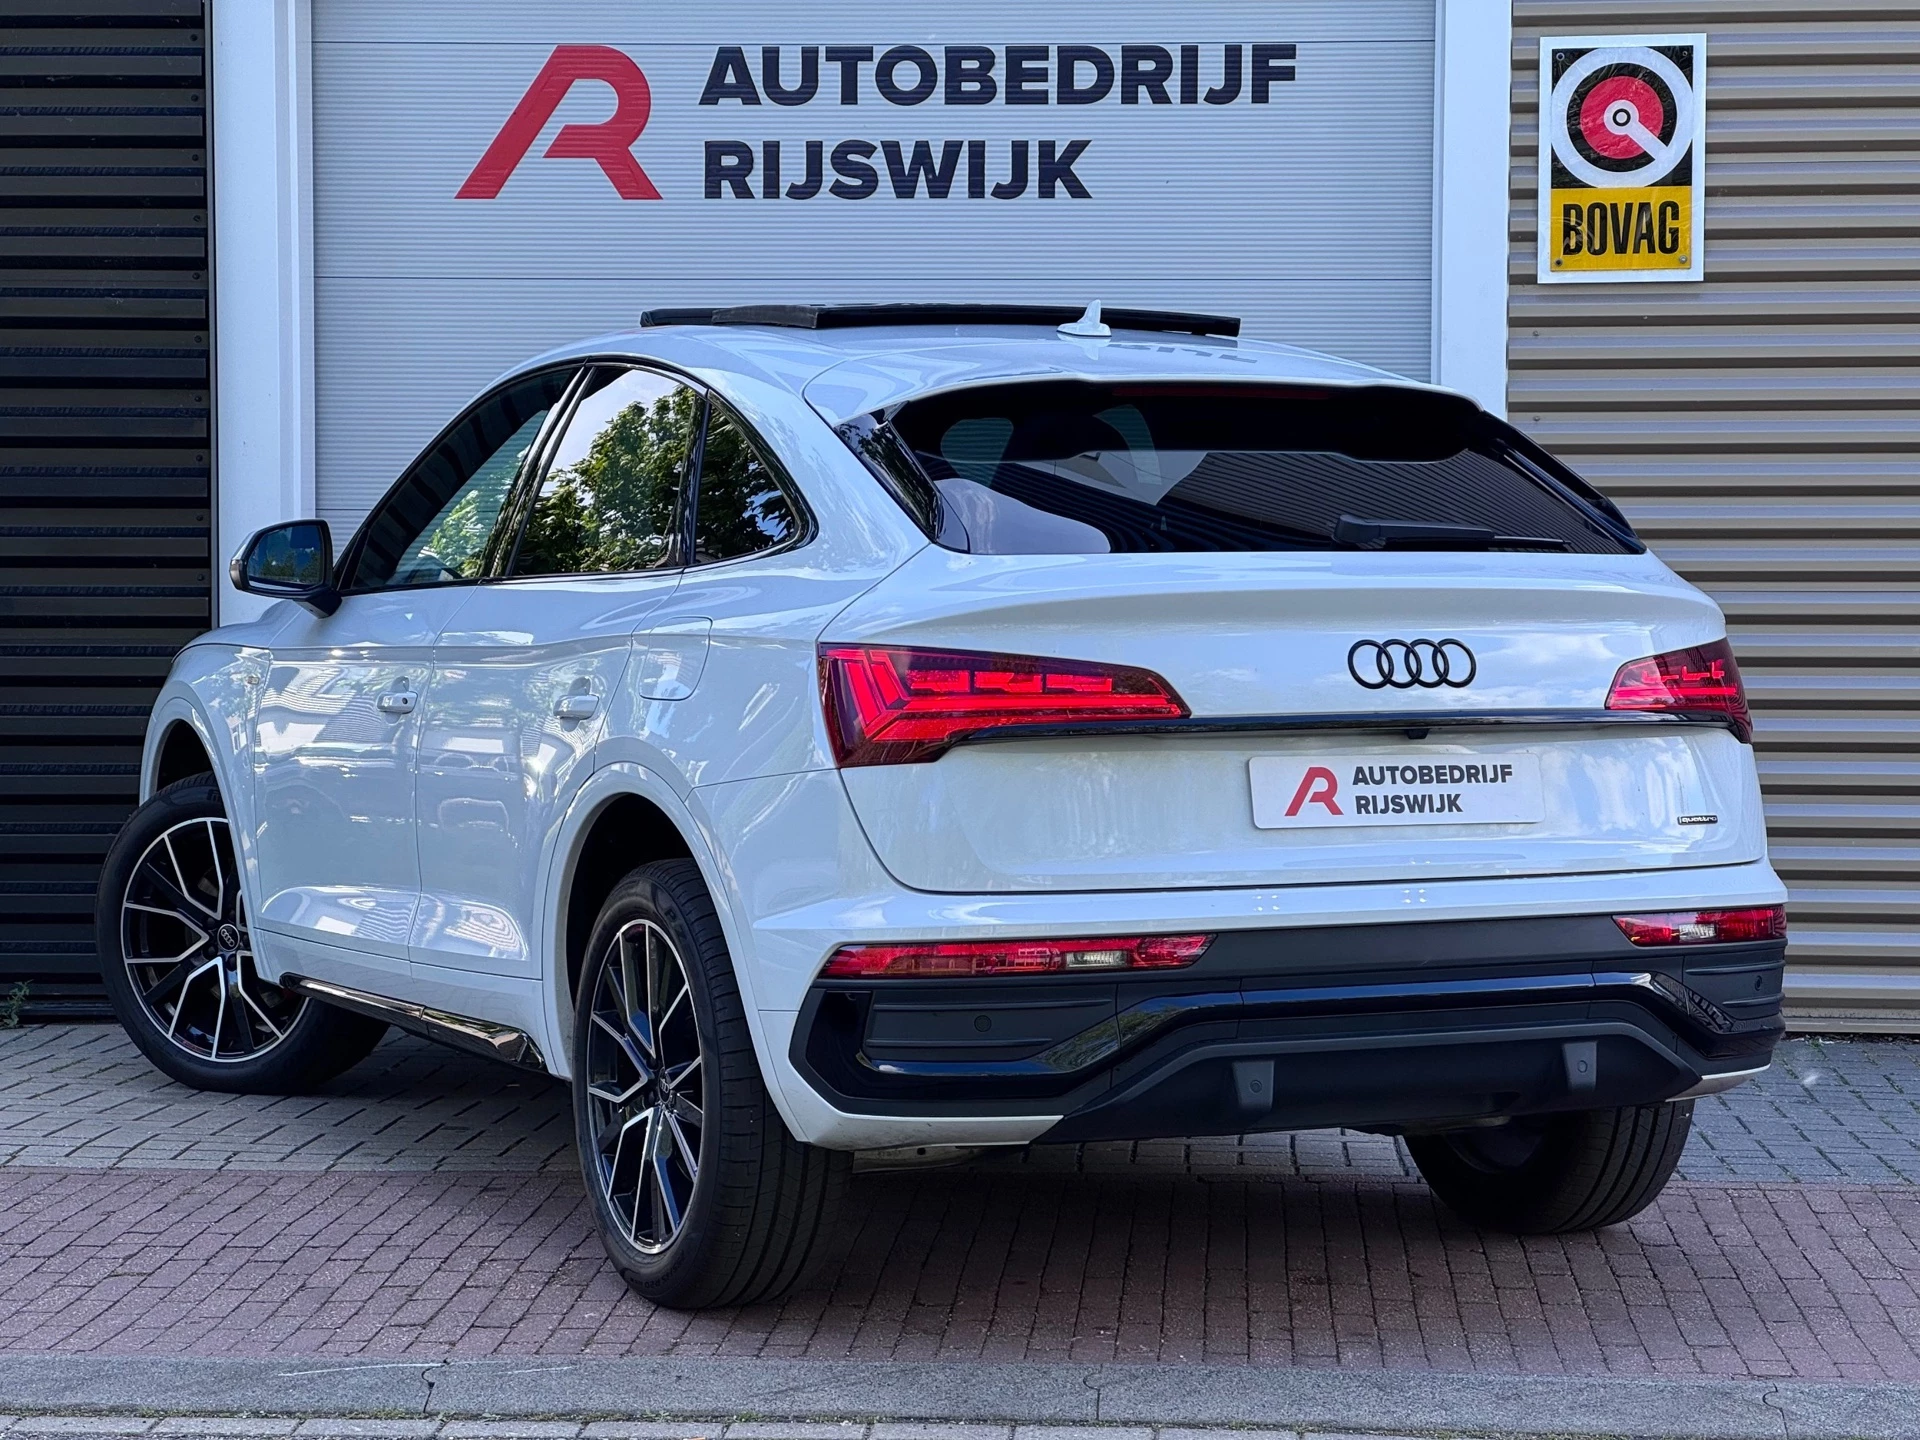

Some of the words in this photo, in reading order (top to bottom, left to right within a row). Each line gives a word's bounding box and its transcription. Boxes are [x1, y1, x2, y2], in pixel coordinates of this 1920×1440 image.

[700, 46, 1296, 106] AUTOBEDRIJF
[705, 140, 1091, 200] RIJSWIJK
[1563, 201, 1679, 255] BOVAG
[1353, 765, 1512, 785] AUTOBEDRIJF
[1356, 794, 1462, 814] RIJSWIJK
[1681, 816, 1717, 824] quattro
